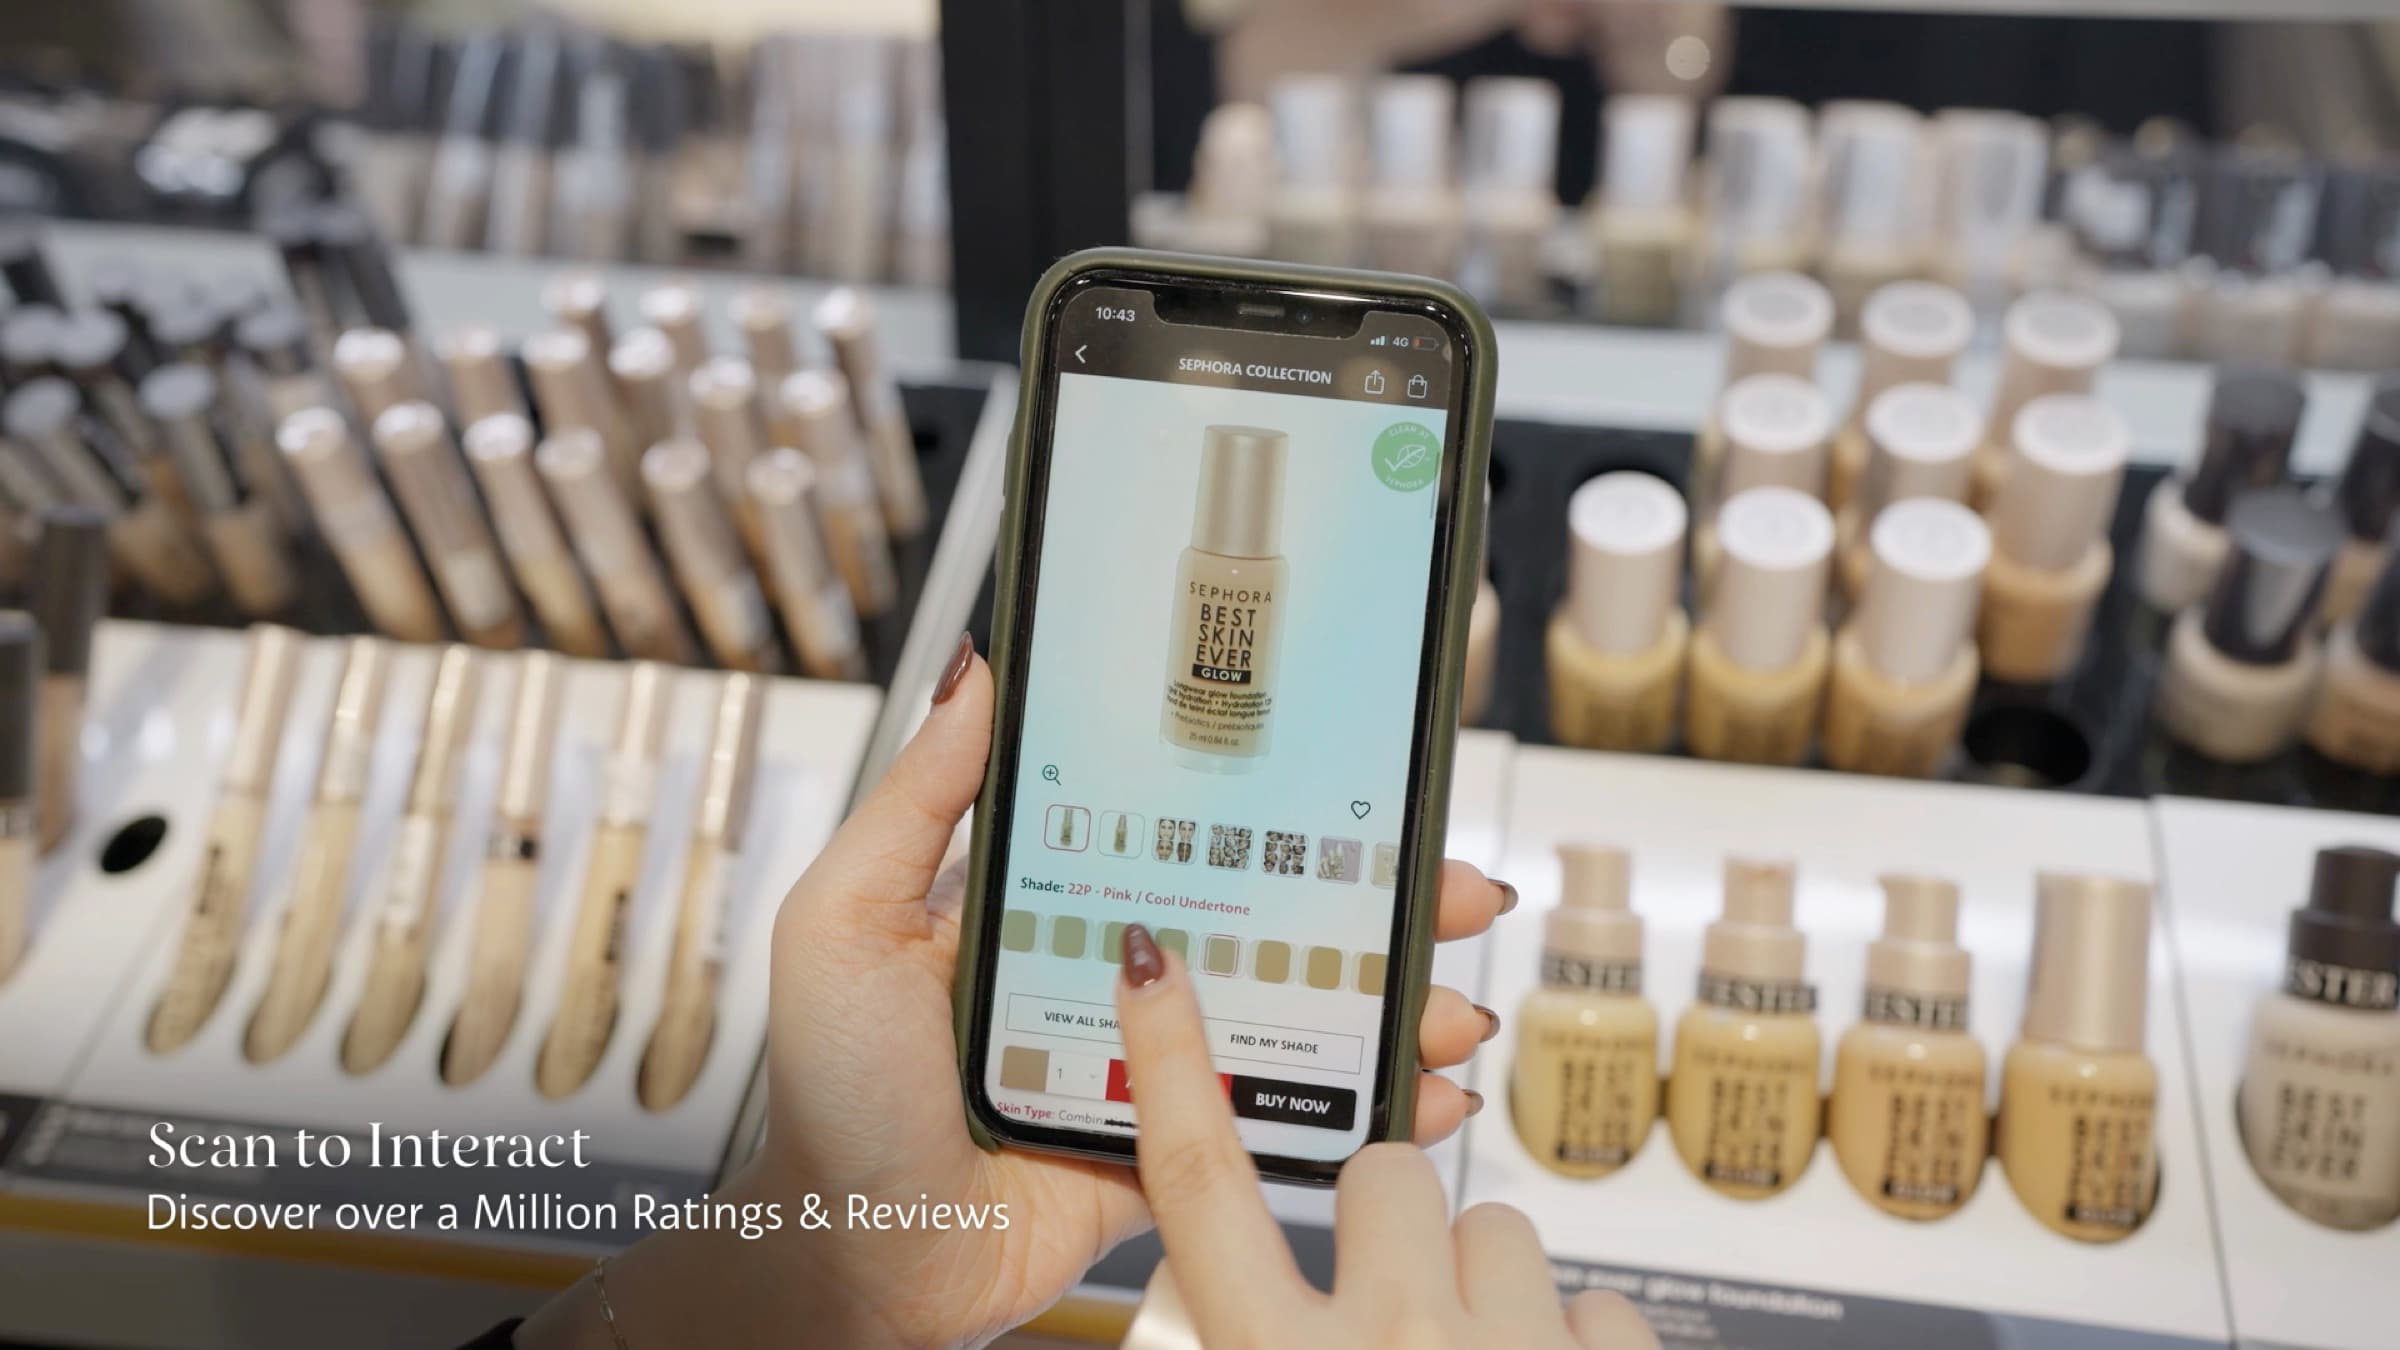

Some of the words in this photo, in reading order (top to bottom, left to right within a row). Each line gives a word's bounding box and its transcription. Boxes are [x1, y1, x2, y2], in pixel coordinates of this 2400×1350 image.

[1094, 306, 1136, 322] 10:43
[1392, 336, 1409, 348] 4G
[1178, 356, 1243, 376] SEPHORA
[1245, 363, 1332, 385] COLLECTION
[1189, 581, 1272, 603] SEPHORA
[1200, 603, 1257, 627] BEST
[1198, 624, 1254, 647] SKIN
[1195, 644, 1252, 669] EVER
[1201, 667, 1242, 682] GLOW
[1020, 876, 1064, 894] Shade:
[1067, 881, 1092, 896] 22P
[1103, 886, 1133, 902] Pink
[1135, 890, 1142, 905] /
[1145, 891, 1176, 907] Cool
[1178, 895, 1251, 916] Undertone
[1044, 1010, 1074, 1025] VIEW
[1076, 1014, 1096, 1028] ALL
[1099, 1018, 1121, 1031] SHA
[1230, 1033, 1256, 1047] FIND
[1259, 1036, 1278, 1050] MY
[1281, 1039, 1319, 1054] SHADE
[1057, 1068, 1063, 1080] 1
[997, 1101, 1021, 1115] Skin
[1024, 1105, 1056, 1120] Type:
[1255, 1092, 1285, 1112] BUY
[1289, 1096, 1331, 1115] NOW
